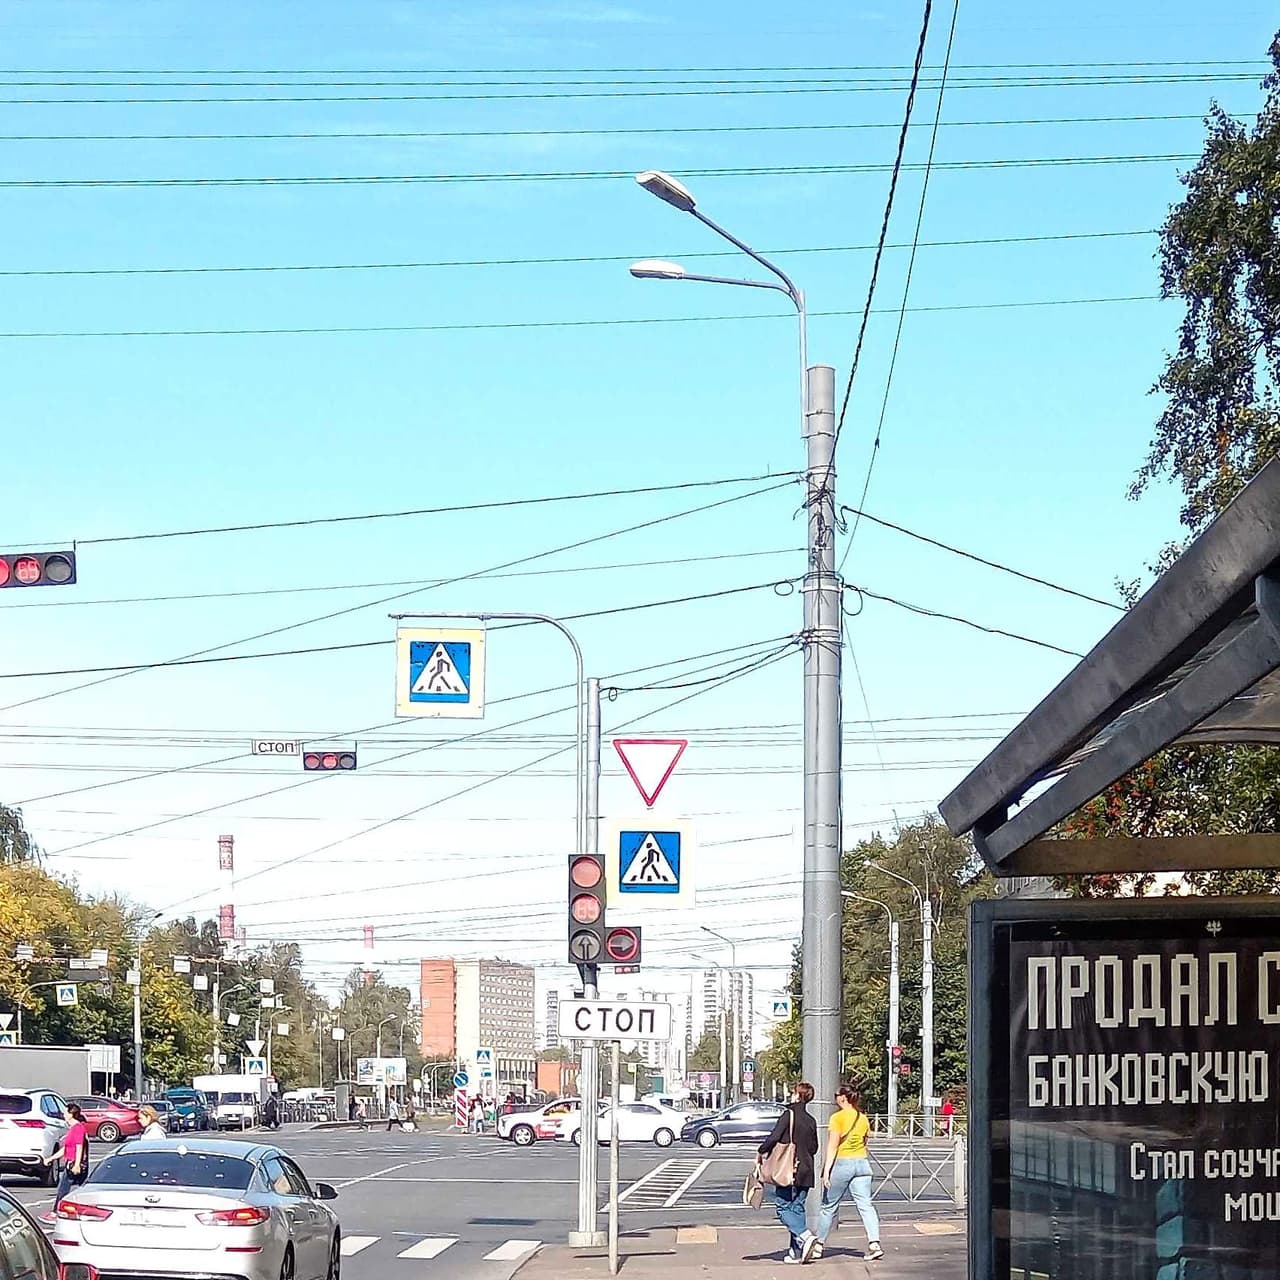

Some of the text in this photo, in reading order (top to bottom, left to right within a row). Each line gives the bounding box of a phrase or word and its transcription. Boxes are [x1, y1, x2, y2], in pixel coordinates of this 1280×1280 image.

[258, 742, 294, 753] СТОП
[1026, 951, 1238, 1030] ПРОДАЛ
[574, 1006, 655, 1033] СТОП
[1028, 1049, 1270, 1108] БАНКОВСКУЮ
